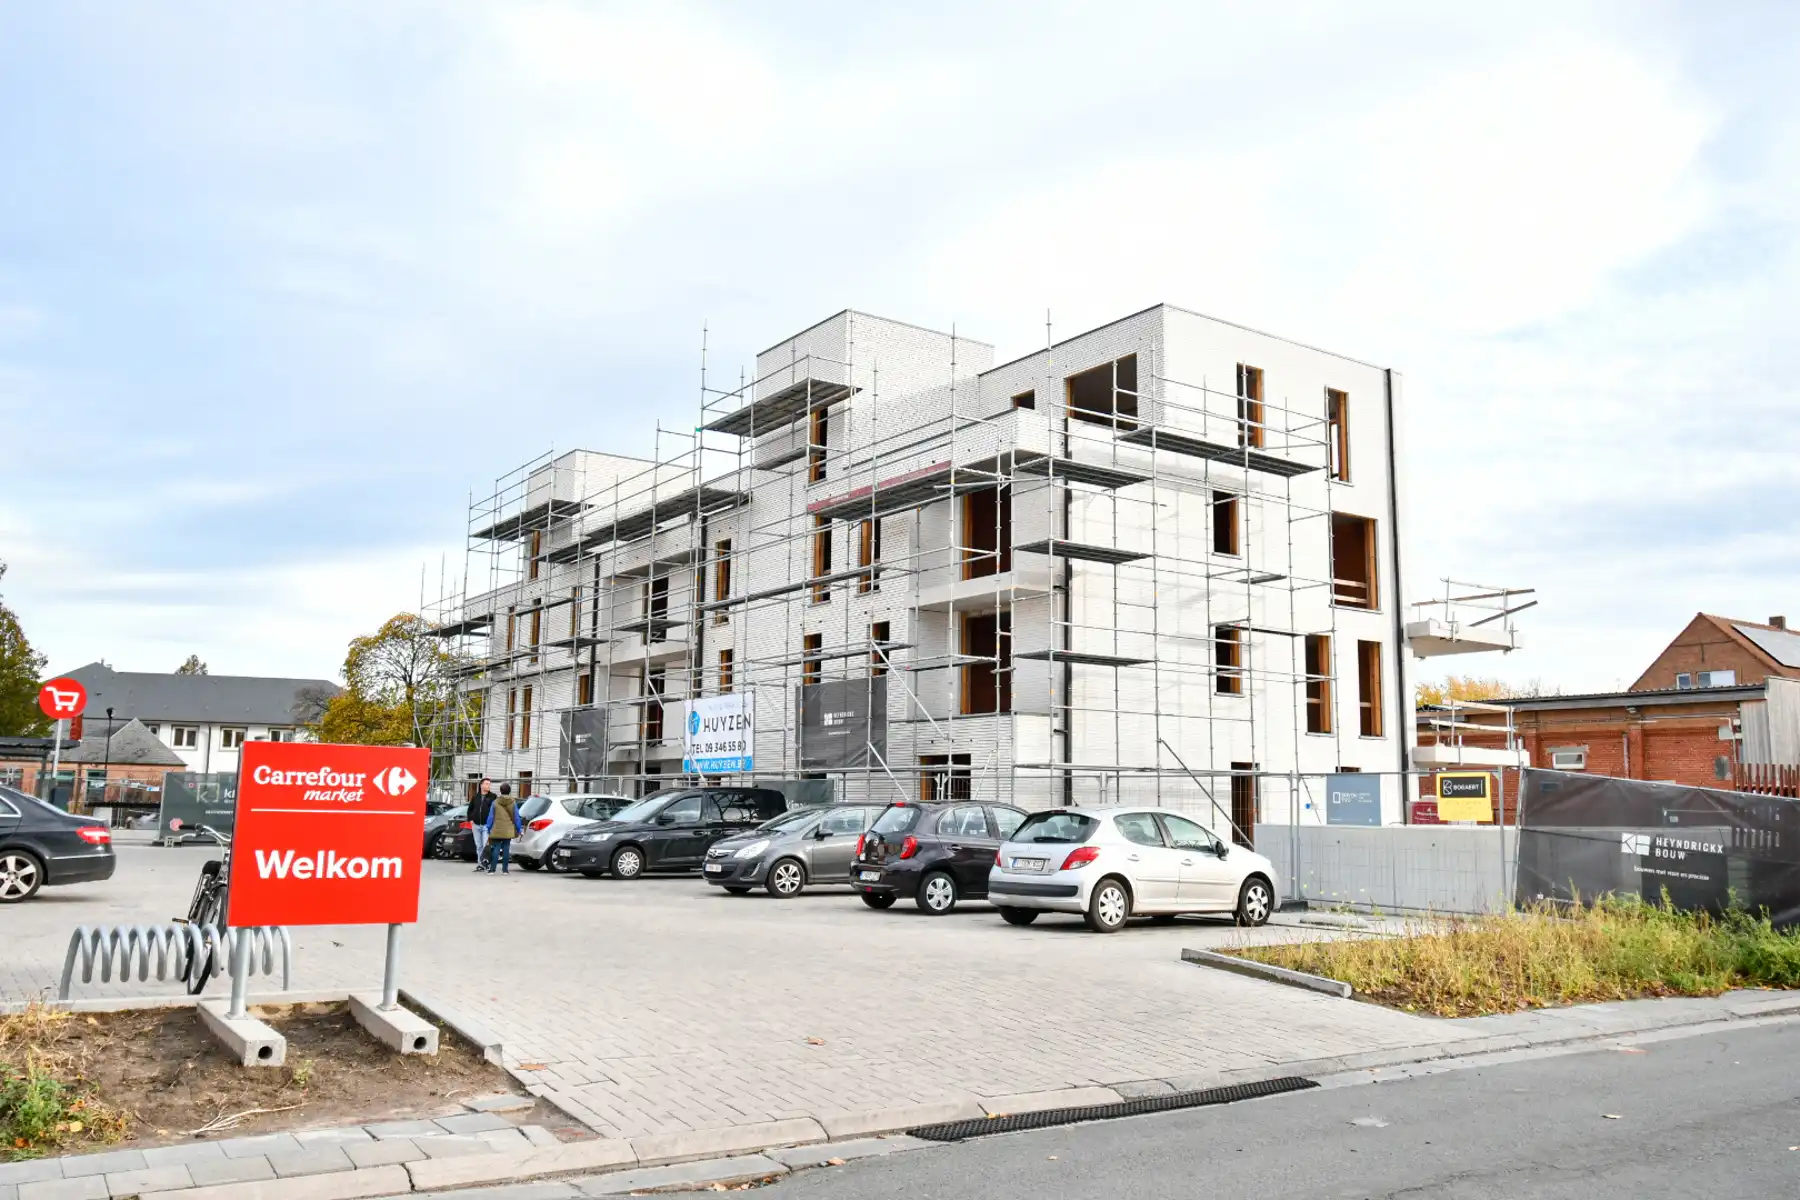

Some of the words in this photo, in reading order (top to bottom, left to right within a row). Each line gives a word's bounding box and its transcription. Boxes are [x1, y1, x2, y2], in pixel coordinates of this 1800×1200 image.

[703, 713, 751, 732] HUYZEN
[691, 743, 703, 754] TEL
[705, 742, 713, 753] 09
[714, 741, 727, 752] 346
[728, 740, 737, 752] 55
[253, 765, 366, 788] Carrefour
[303, 788, 365, 803] market
[1655, 847, 1686, 860] BOUW
[1656, 837, 1723, 854] HEYNDRICKX
[254, 850, 403, 879] Welkom
